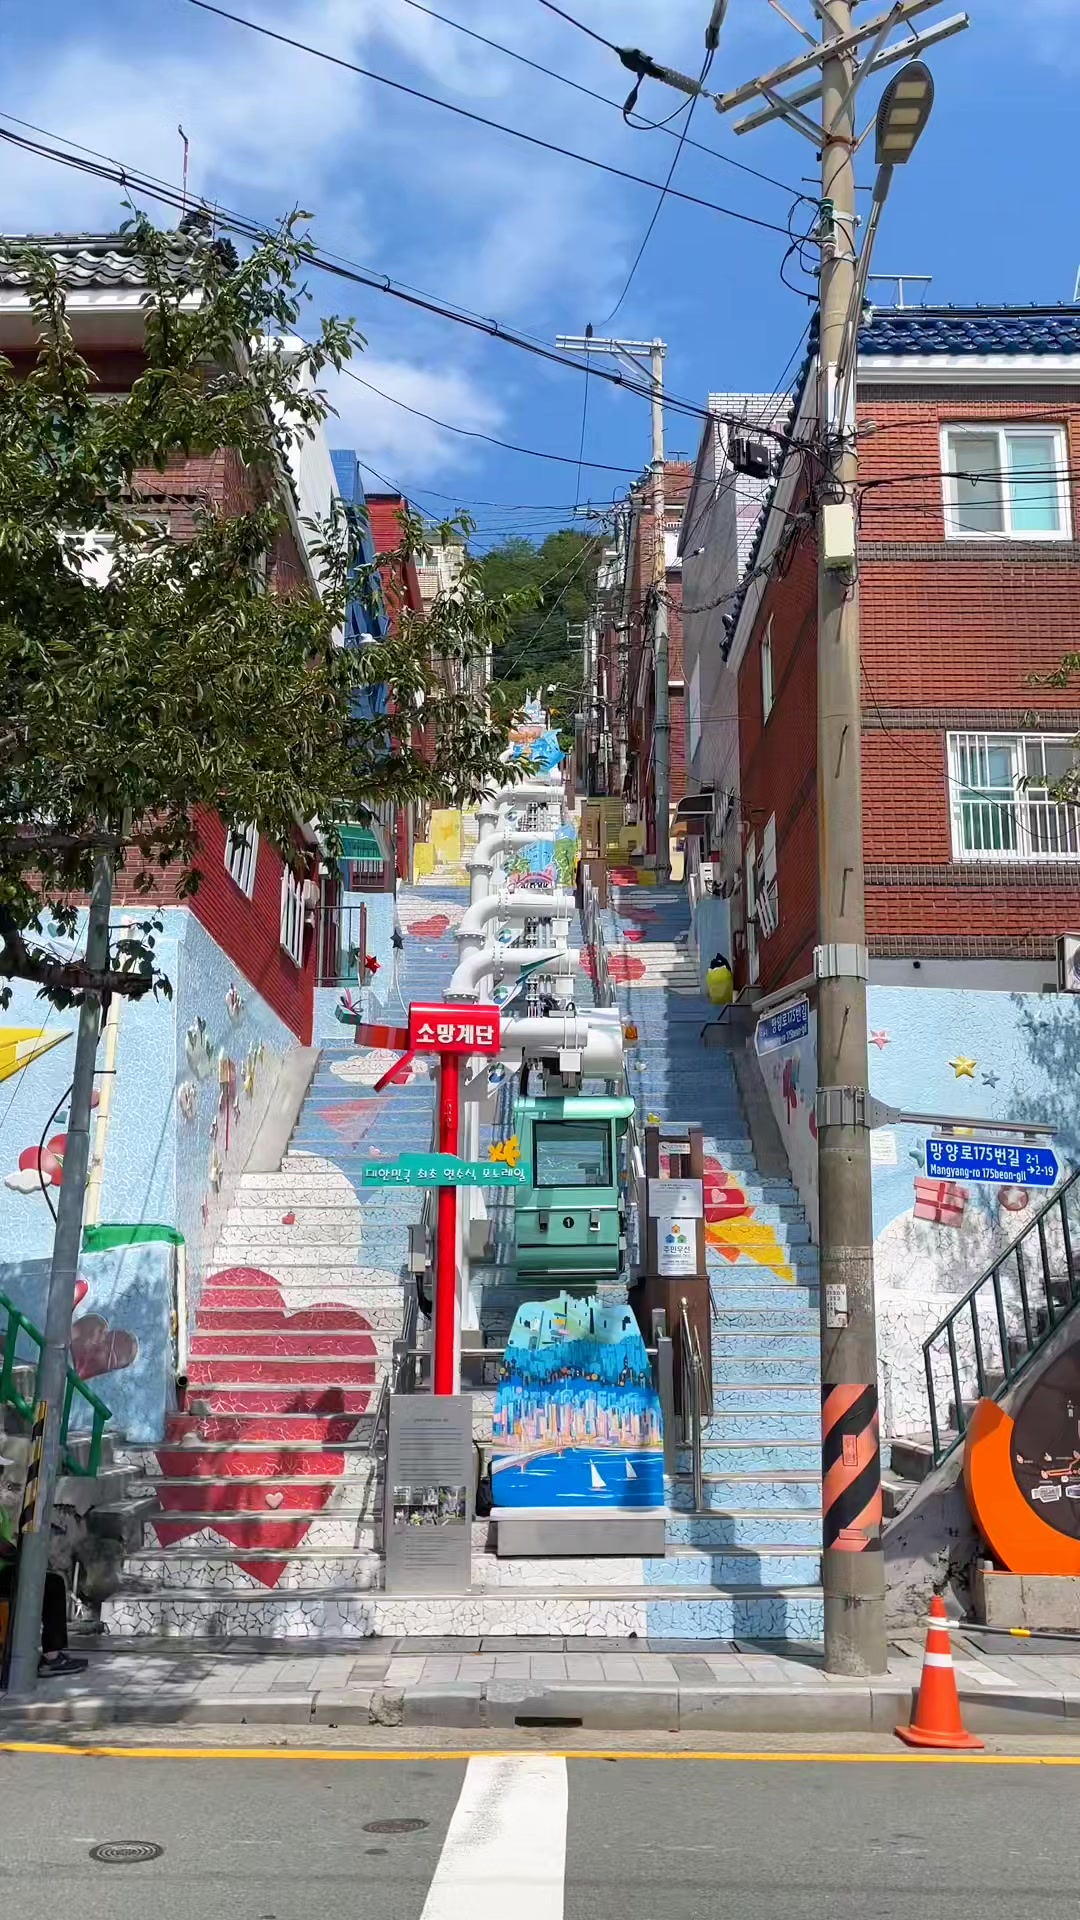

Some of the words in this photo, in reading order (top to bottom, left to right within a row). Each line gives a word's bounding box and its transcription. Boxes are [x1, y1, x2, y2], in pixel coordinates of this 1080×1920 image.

[416, 1023, 495, 1045] 소망계단
[930, 1143, 1020, 1167] 망양로175번길
[1026, 1153, 1039, 1164] 2-1
[365, 1168, 411, 1183] 대한민국
[417, 1168, 437, 1178] 최초
[482, 1168, 526, 1182] 모노레일
[930, 1164, 981, 1179] Mangyang-ro
[982, 1168, 1027, 1183] 175beon-gil
[1035, 1165, 1054, 1176] 2-19
